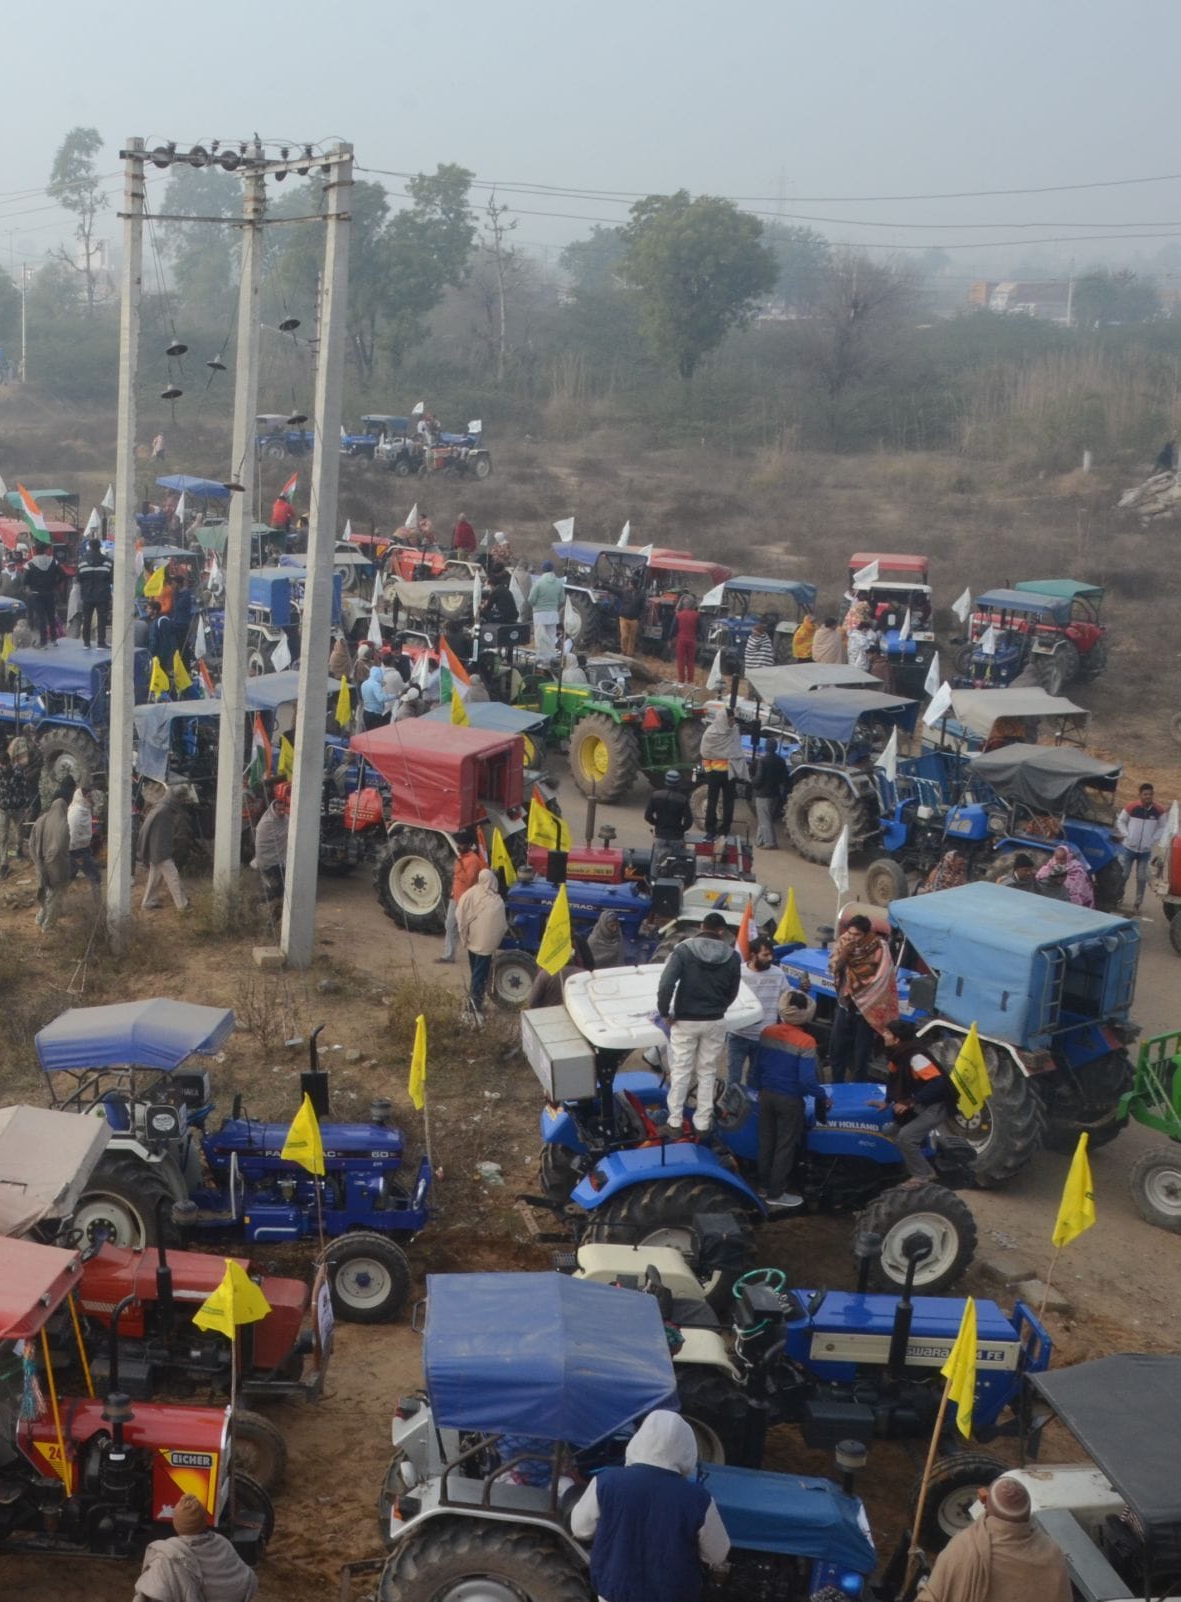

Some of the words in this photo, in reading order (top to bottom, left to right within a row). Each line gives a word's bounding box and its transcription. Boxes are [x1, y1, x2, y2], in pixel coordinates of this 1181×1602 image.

[541, 900, 594, 910] FATRAC
[839, 1121, 879, 1131] HOLLAND
[986, 1351, 1003, 1361] FE
[172, 1454, 210, 1465] EICHER
